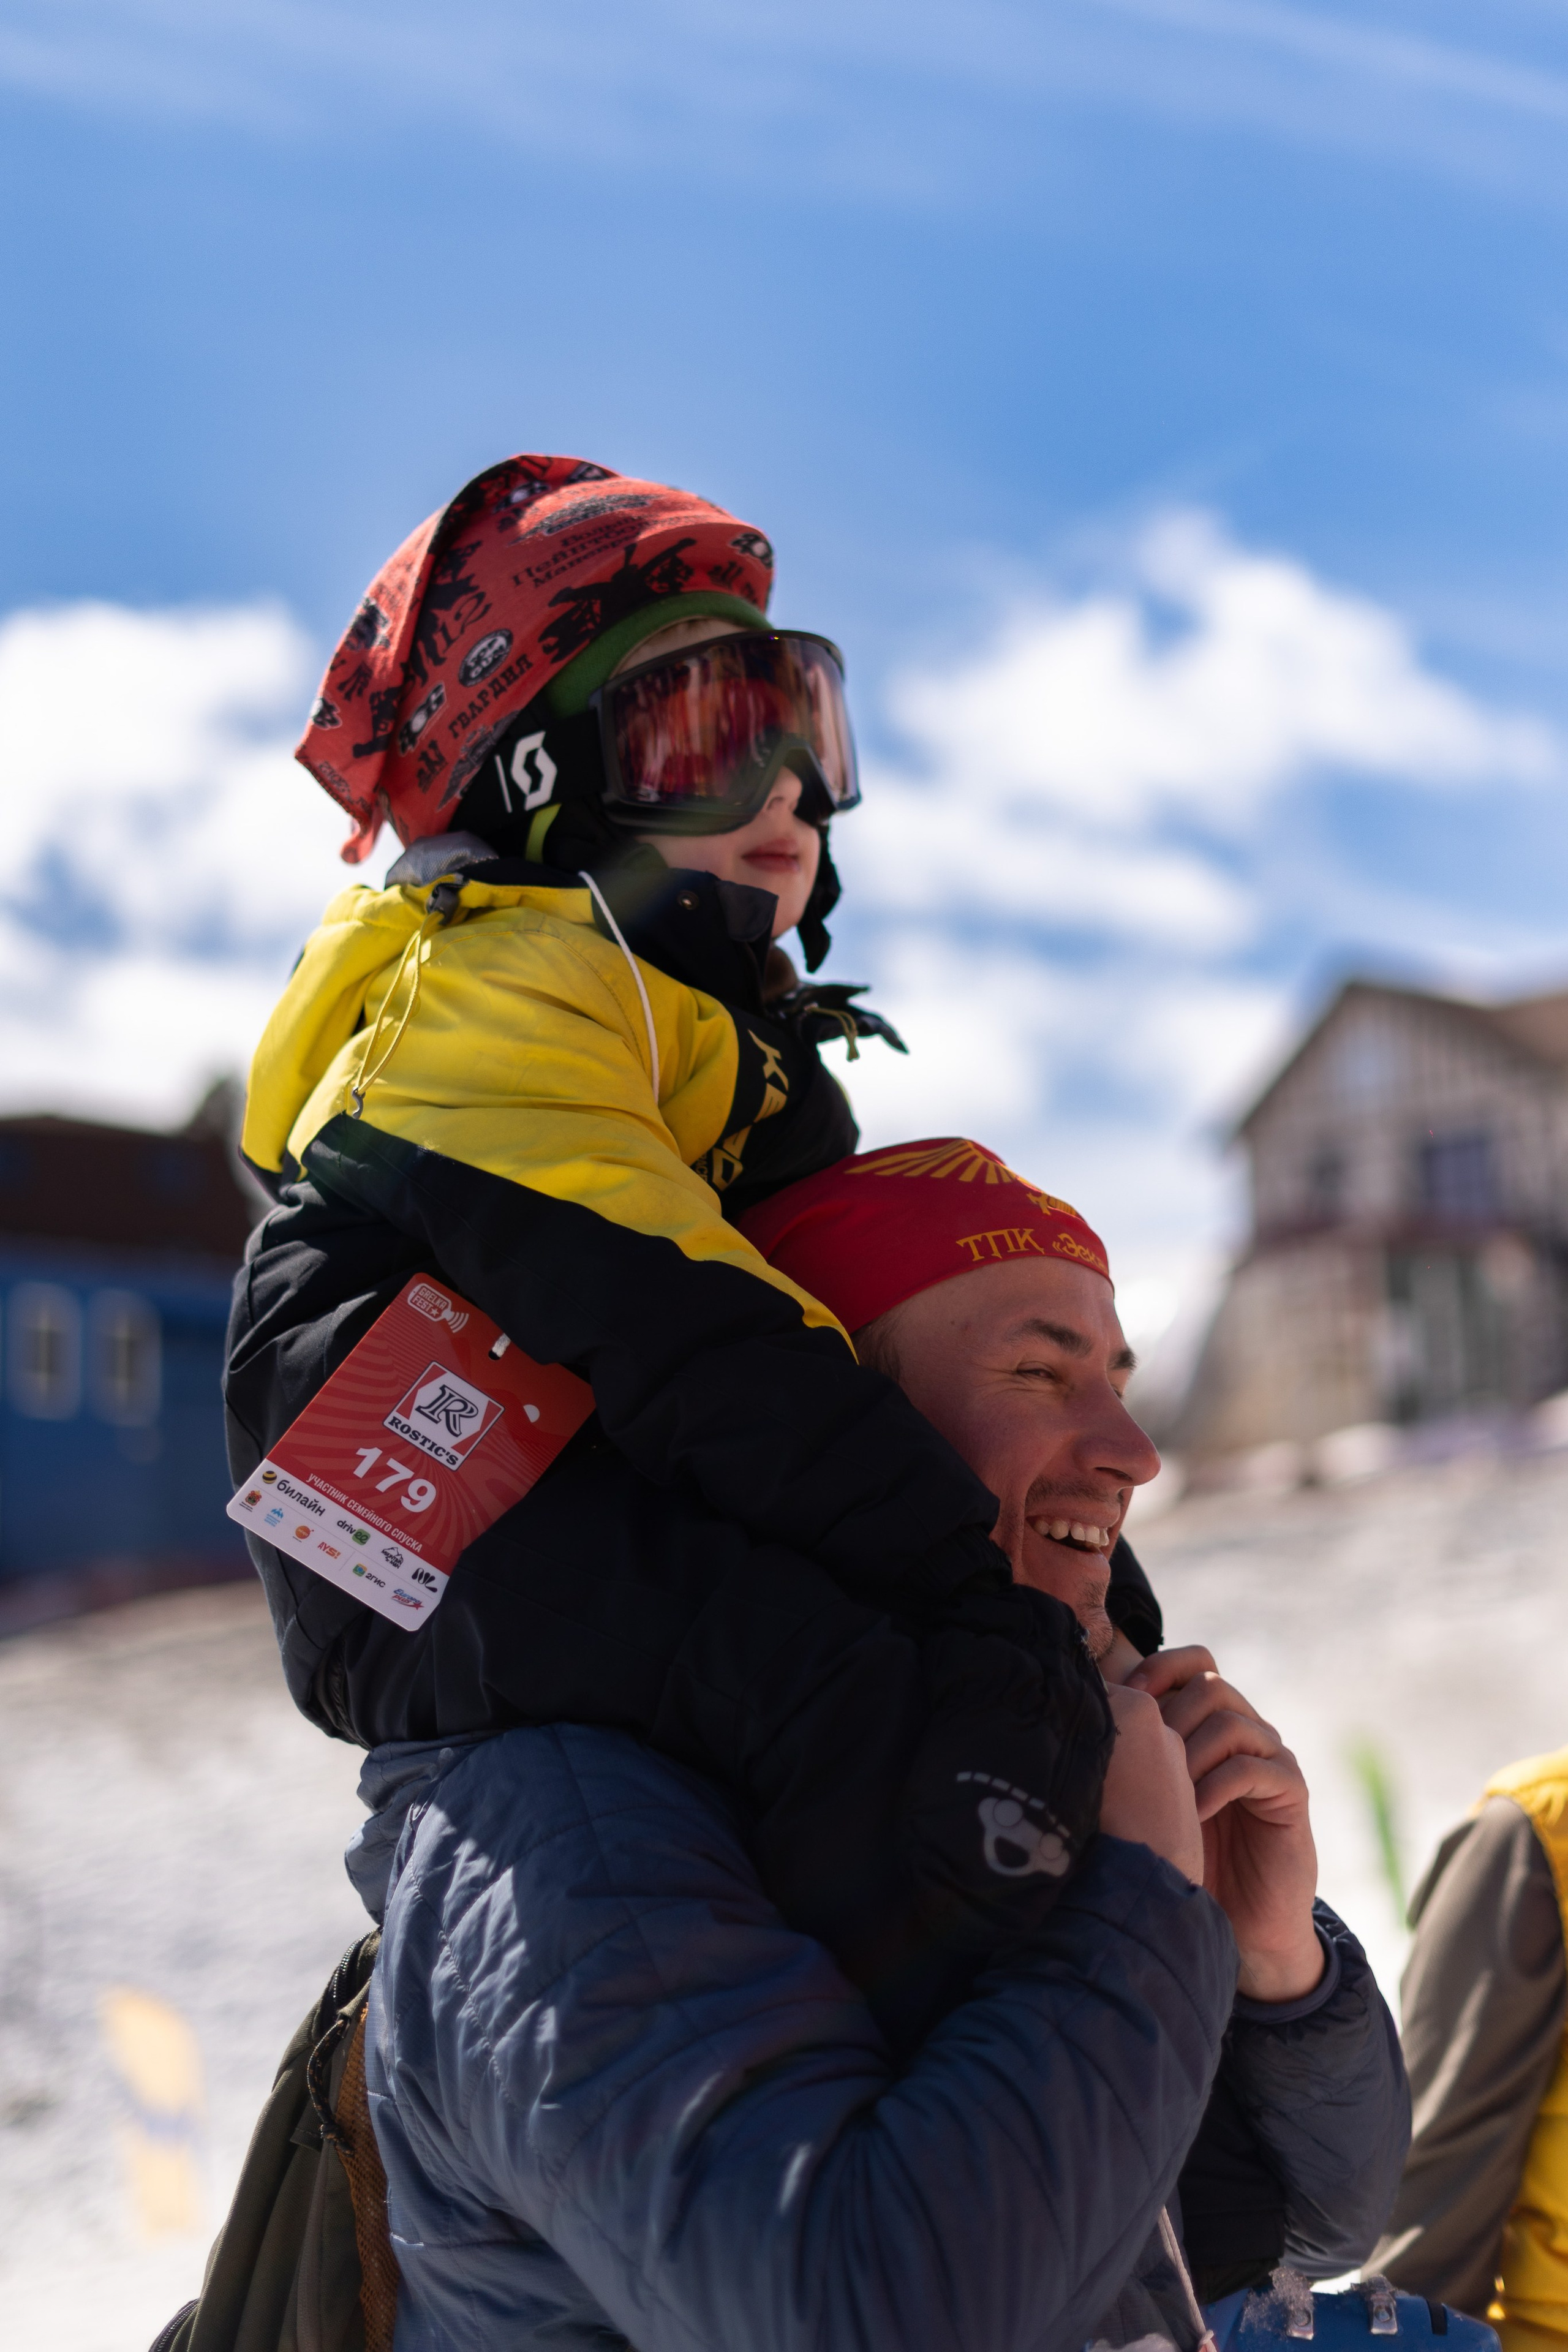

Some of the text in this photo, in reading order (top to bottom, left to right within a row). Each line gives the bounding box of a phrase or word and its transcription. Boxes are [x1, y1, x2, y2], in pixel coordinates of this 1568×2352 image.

[956, 1228, 1045, 1262] ТПК
[412, 1295, 434, 1312] FEST
[418, 1287, 448, 1310] GRELKA
[388, 1416, 459, 1466] ROSTIC'S
[353, 1447, 437, 1513] 179
[277, 1479, 326, 1517] билайн
[306, 1473, 423, 1553] УЧАСТНИК СЕМЕЙНОГО СПУСКА
[337, 1520, 369, 1545] drivee
[317, 1541, 341, 1559] AYS!
[365, 1573, 386, 1588] 2ГИС
